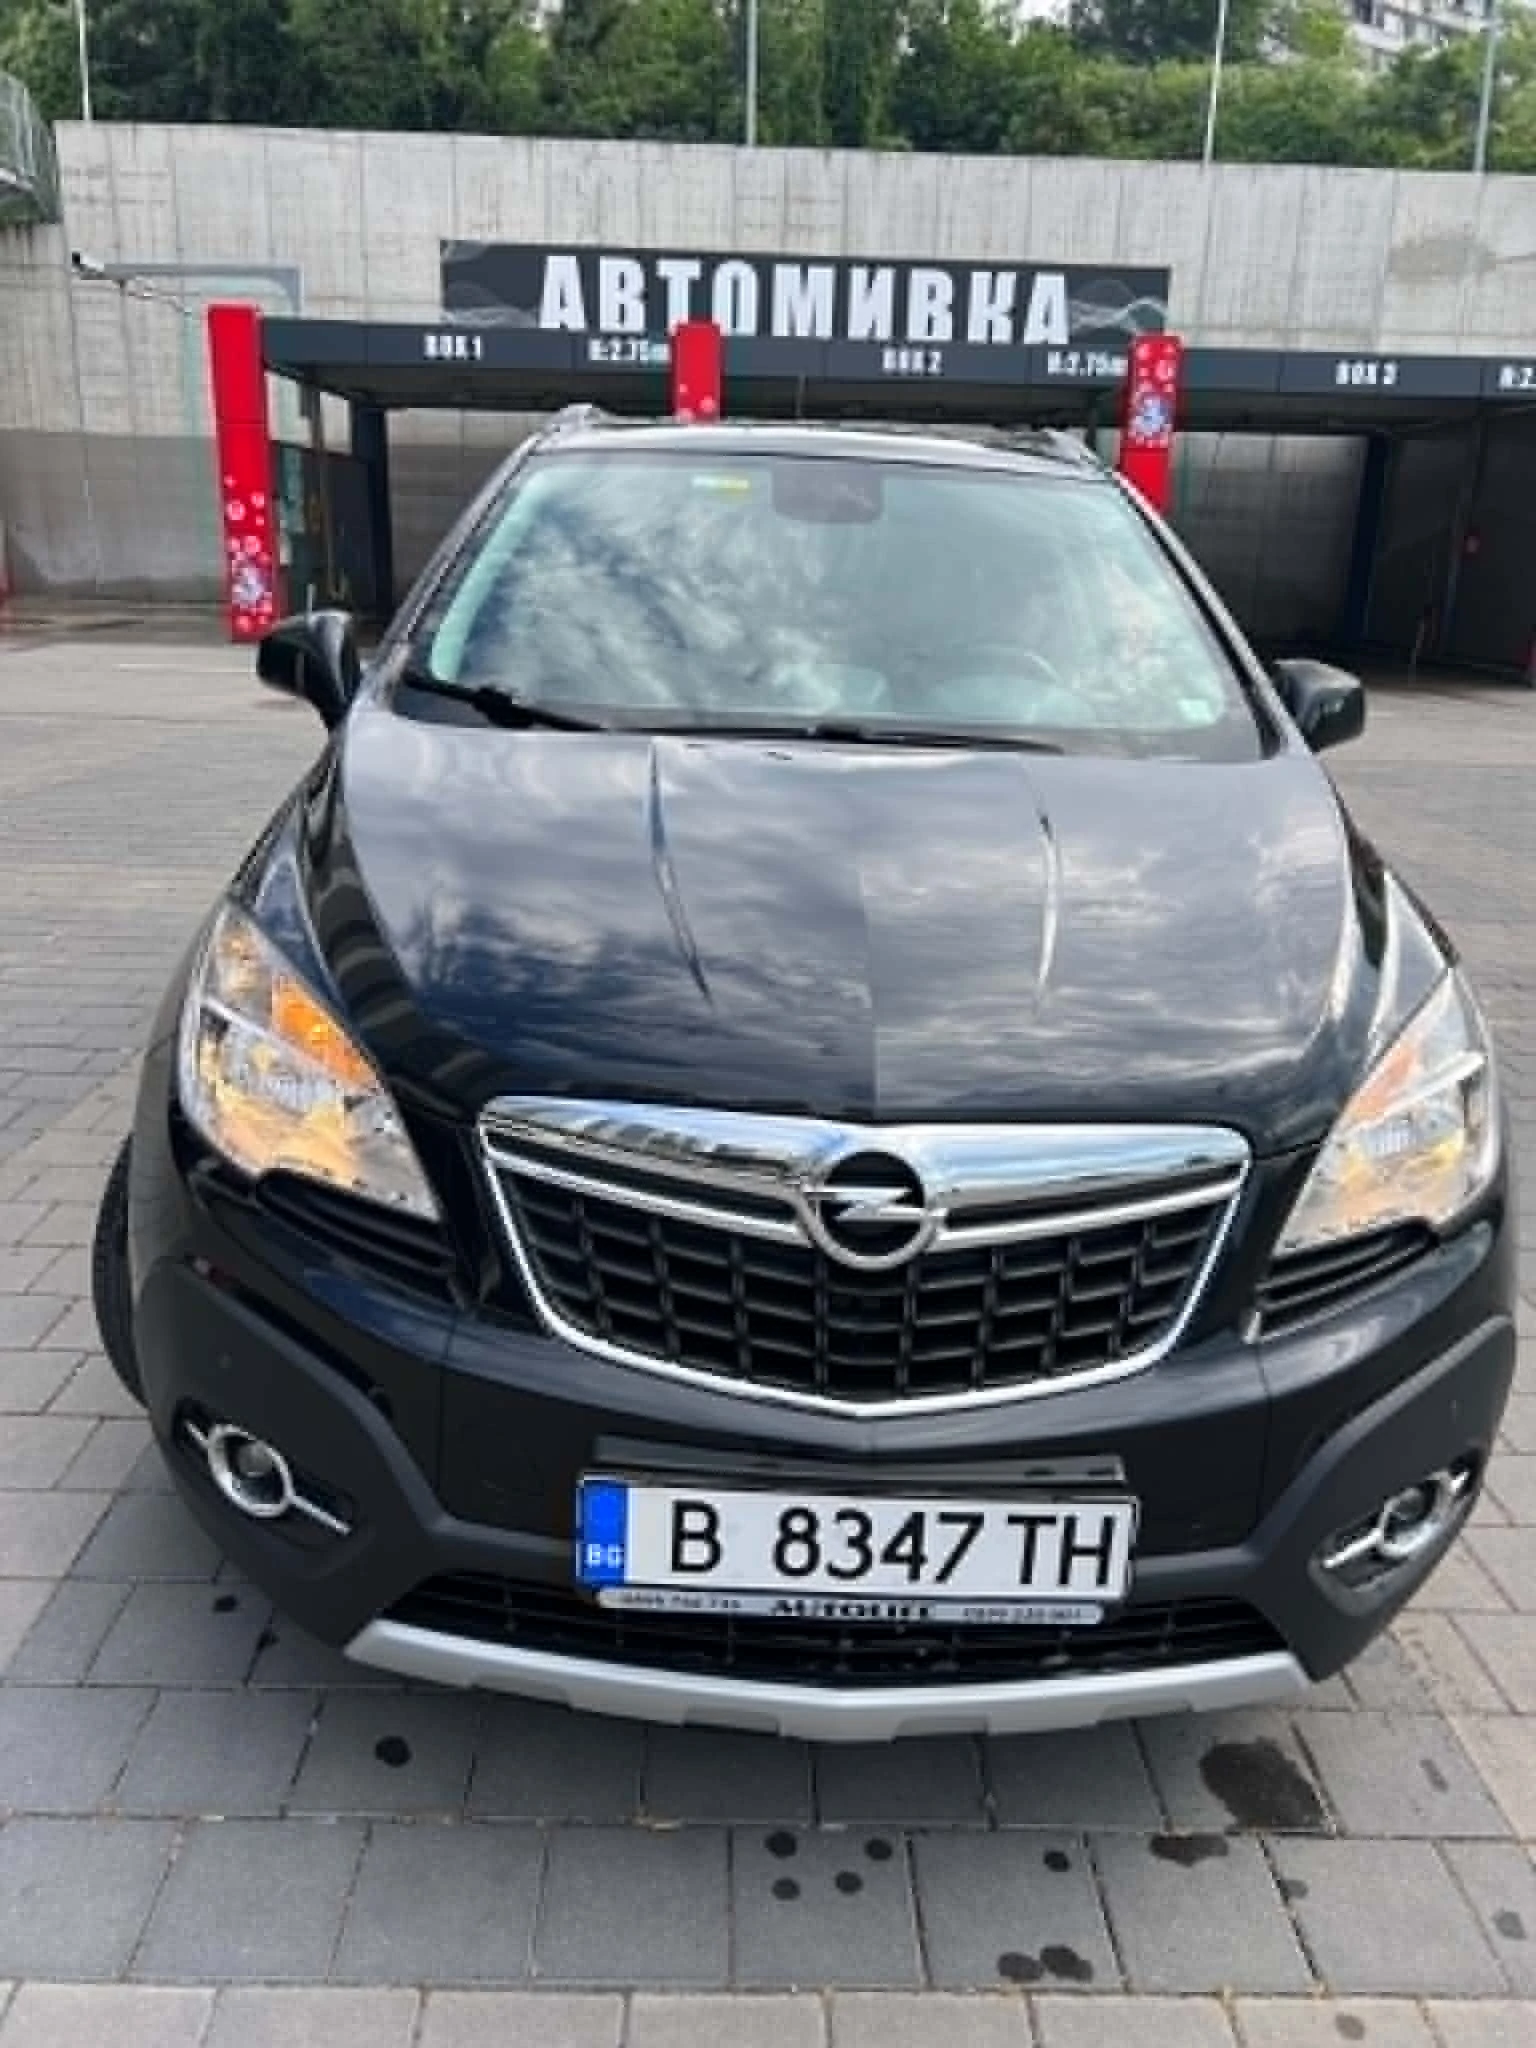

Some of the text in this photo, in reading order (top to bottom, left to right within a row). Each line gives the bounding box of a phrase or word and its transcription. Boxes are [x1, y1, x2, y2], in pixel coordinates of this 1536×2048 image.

[538, 254, 1070, 345] АВТОМИВКА
[670, 1500, 1117, 1586] B 8347 TH
